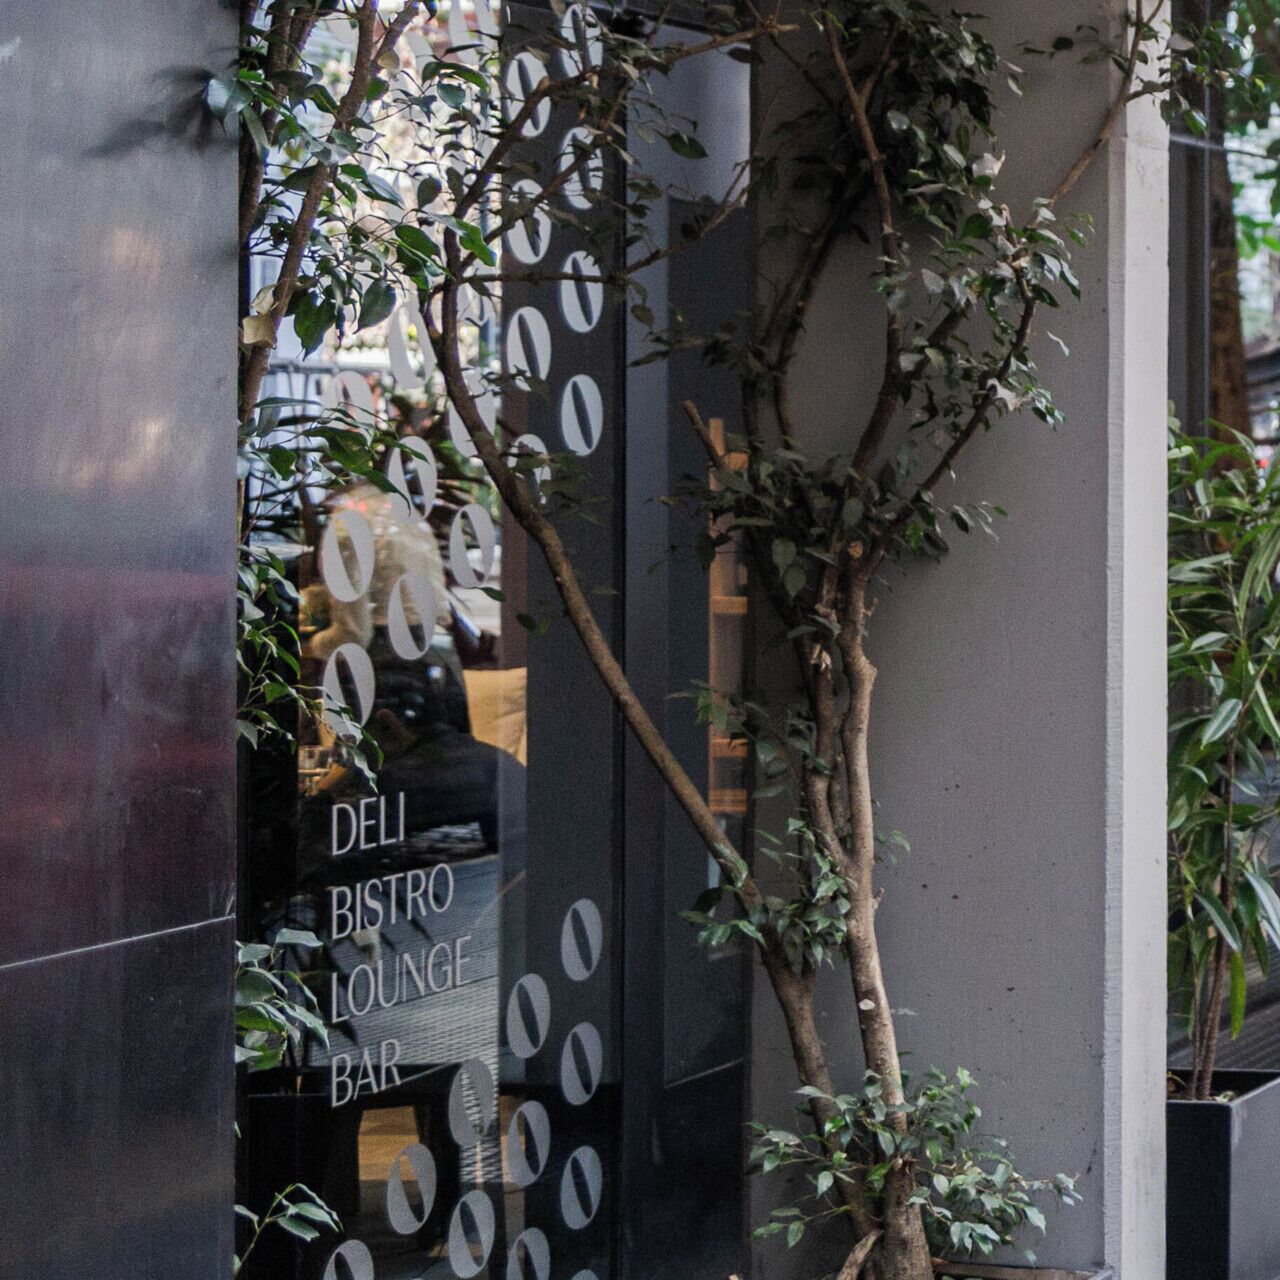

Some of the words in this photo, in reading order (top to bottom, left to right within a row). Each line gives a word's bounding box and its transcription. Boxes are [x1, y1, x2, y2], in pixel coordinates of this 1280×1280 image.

[331, 791, 406, 857] DELI
[331, 863, 455, 941] BISTRO
[330, 935, 473, 1024] LOUNGE
[331, 1037, 402, 1109] BAR
